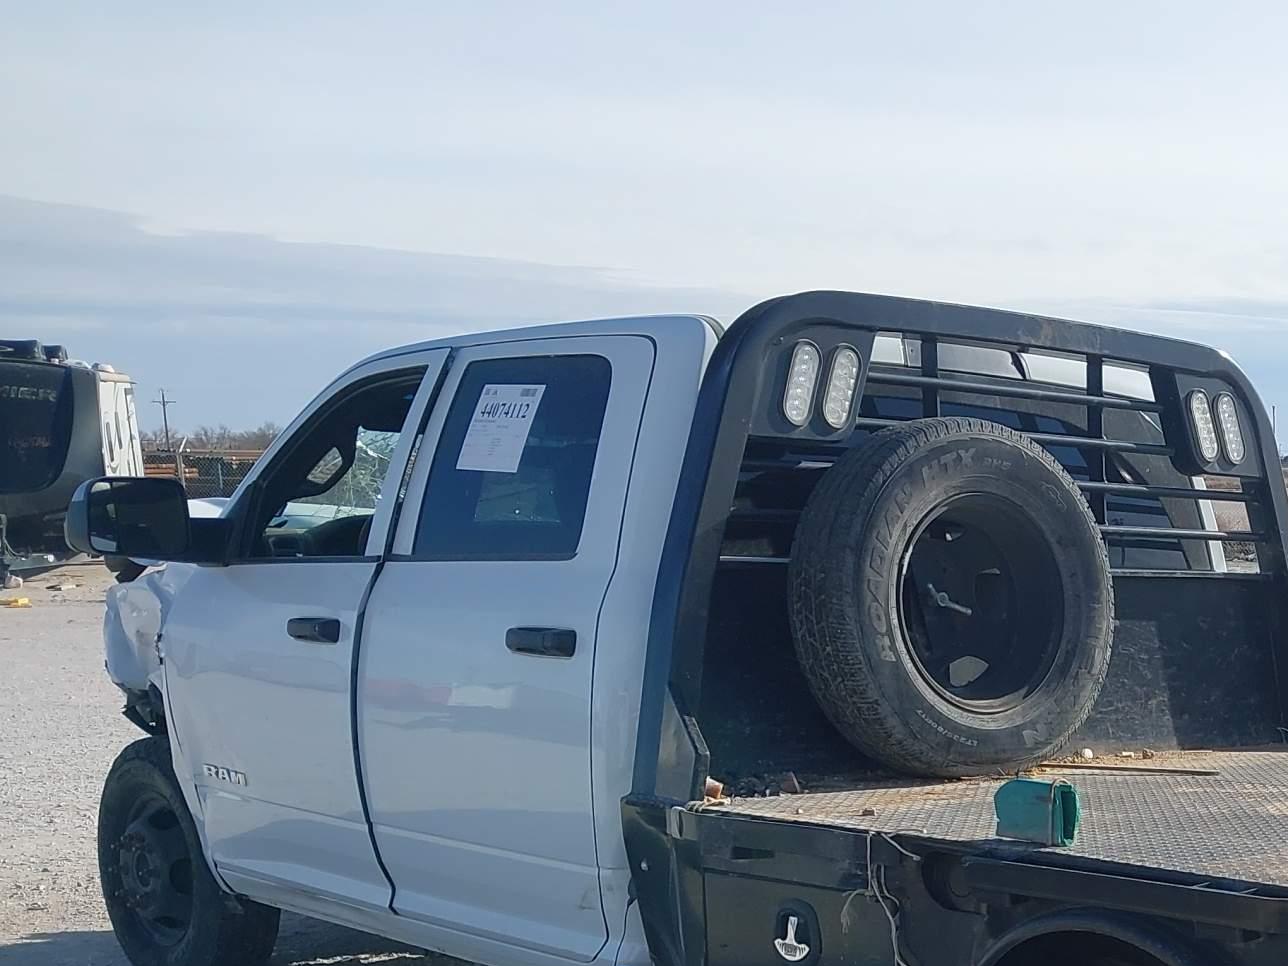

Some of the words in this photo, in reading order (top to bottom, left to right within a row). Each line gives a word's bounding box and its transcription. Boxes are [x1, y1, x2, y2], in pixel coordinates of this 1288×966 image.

[480, 401, 530, 419] 44074112
[921, 447, 976, 488] HTX
[203, 763, 247, 786] RAM
